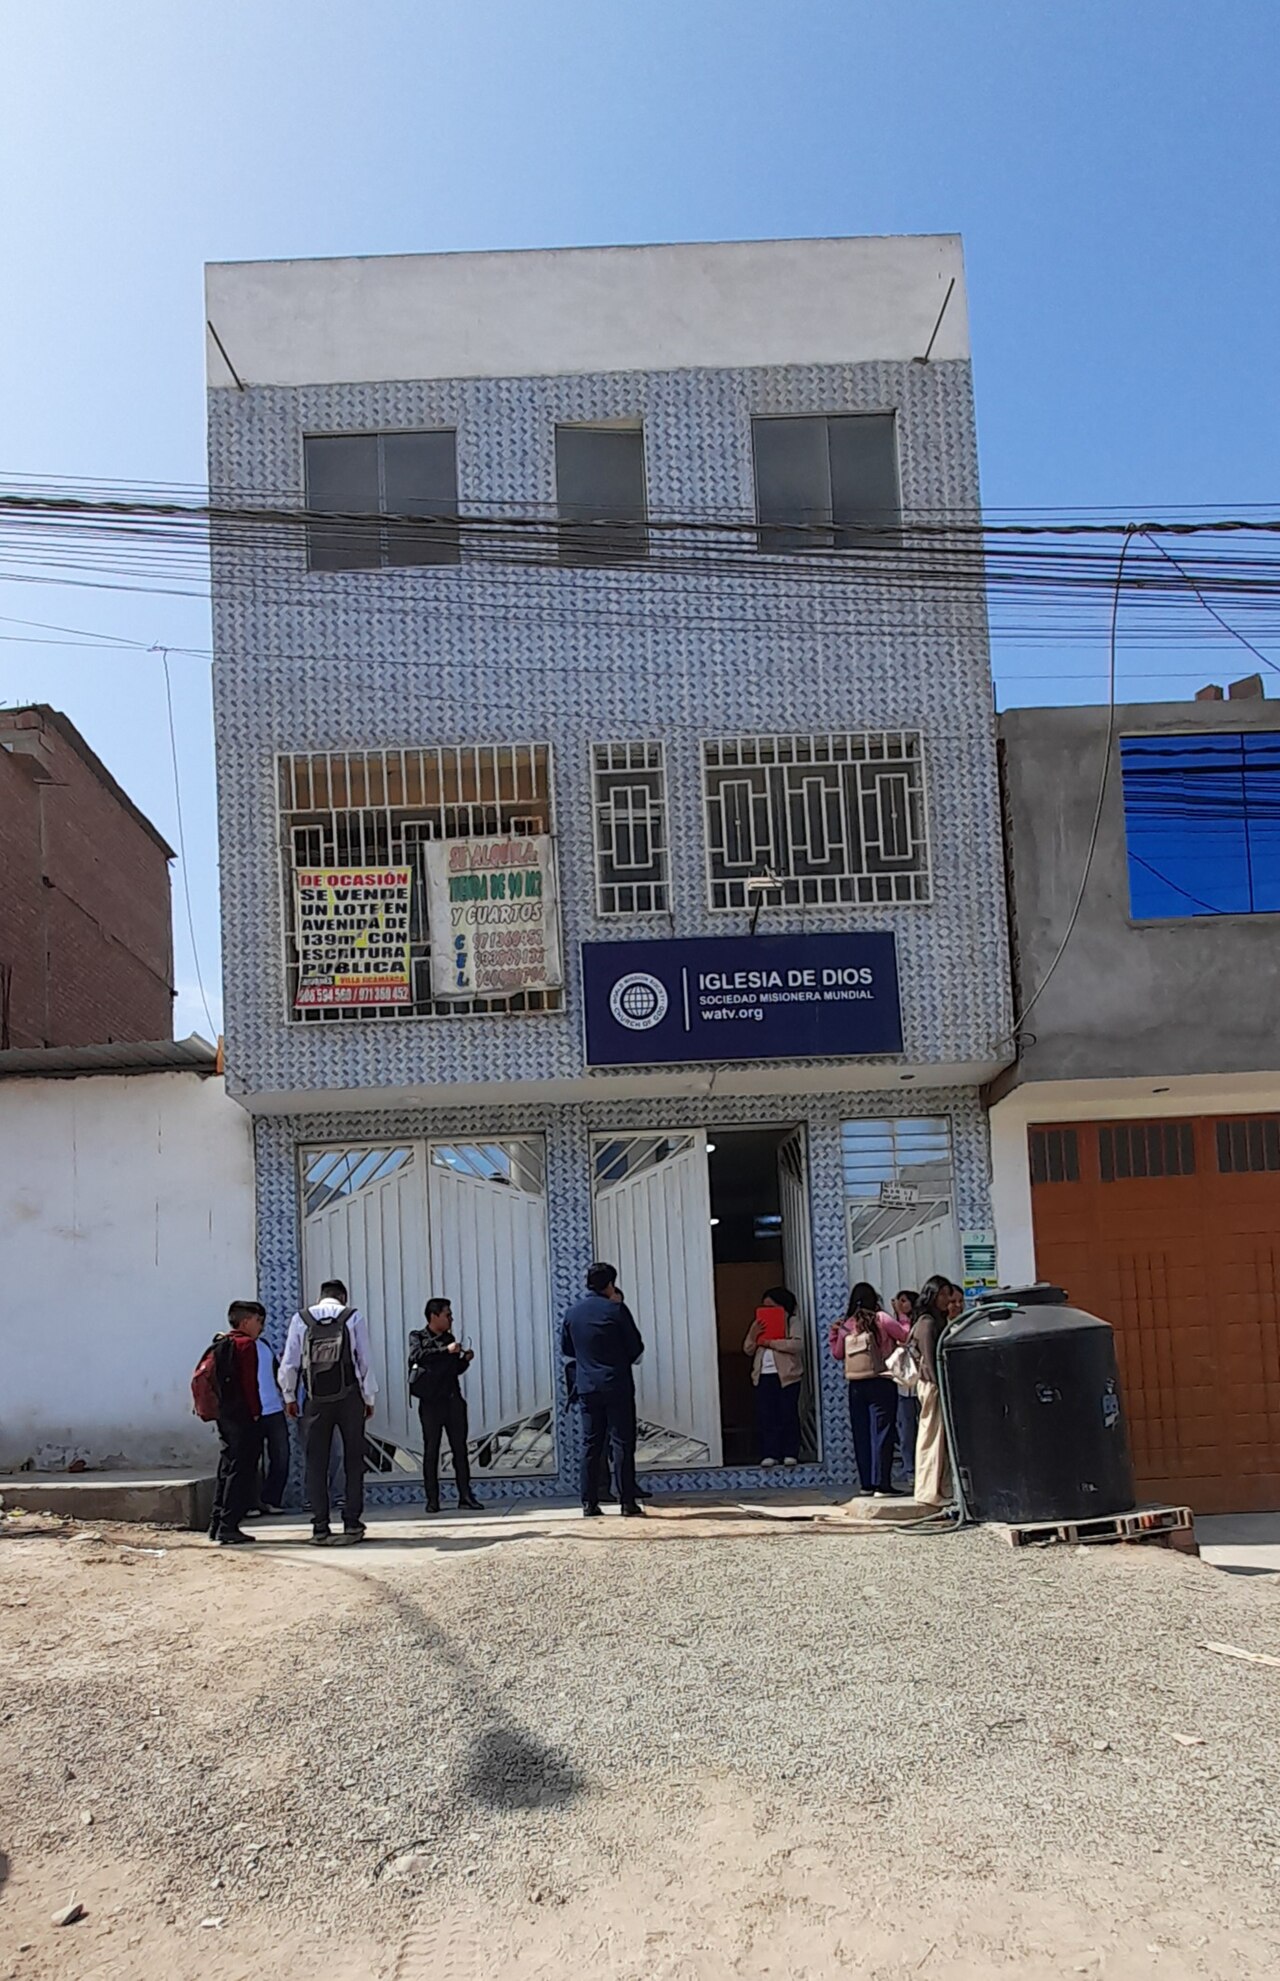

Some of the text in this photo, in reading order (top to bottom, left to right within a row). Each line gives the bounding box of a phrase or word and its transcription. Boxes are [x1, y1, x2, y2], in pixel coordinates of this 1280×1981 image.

[448, 846, 468, 868] SE
[300, 871, 409, 887] DE OCASIÓN
[301, 887, 409, 901] SE VENDE
[448, 874, 488, 902] TIENDA
[490, 873, 506, 900] DE
[301, 902, 408, 916] UN LOTE EN
[451, 901, 544, 926] Y CUARTOS
[302, 917, 407, 931] AVENIDA DE
[368, 932, 408, 944] CON
[302, 947, 406, 961] ESCRITURA
[302, 961, 406, 975] PUBLICA
[699, 967, 873, 991] IGLESIA DE DIOS
[699, 989, 875, 1006] SOCIEDAD MISIONERA MUNDIAL
[614, 1005, 665, 1028] CHURCH OF GOD
[701, 1007, 764, 1022] watv.org
